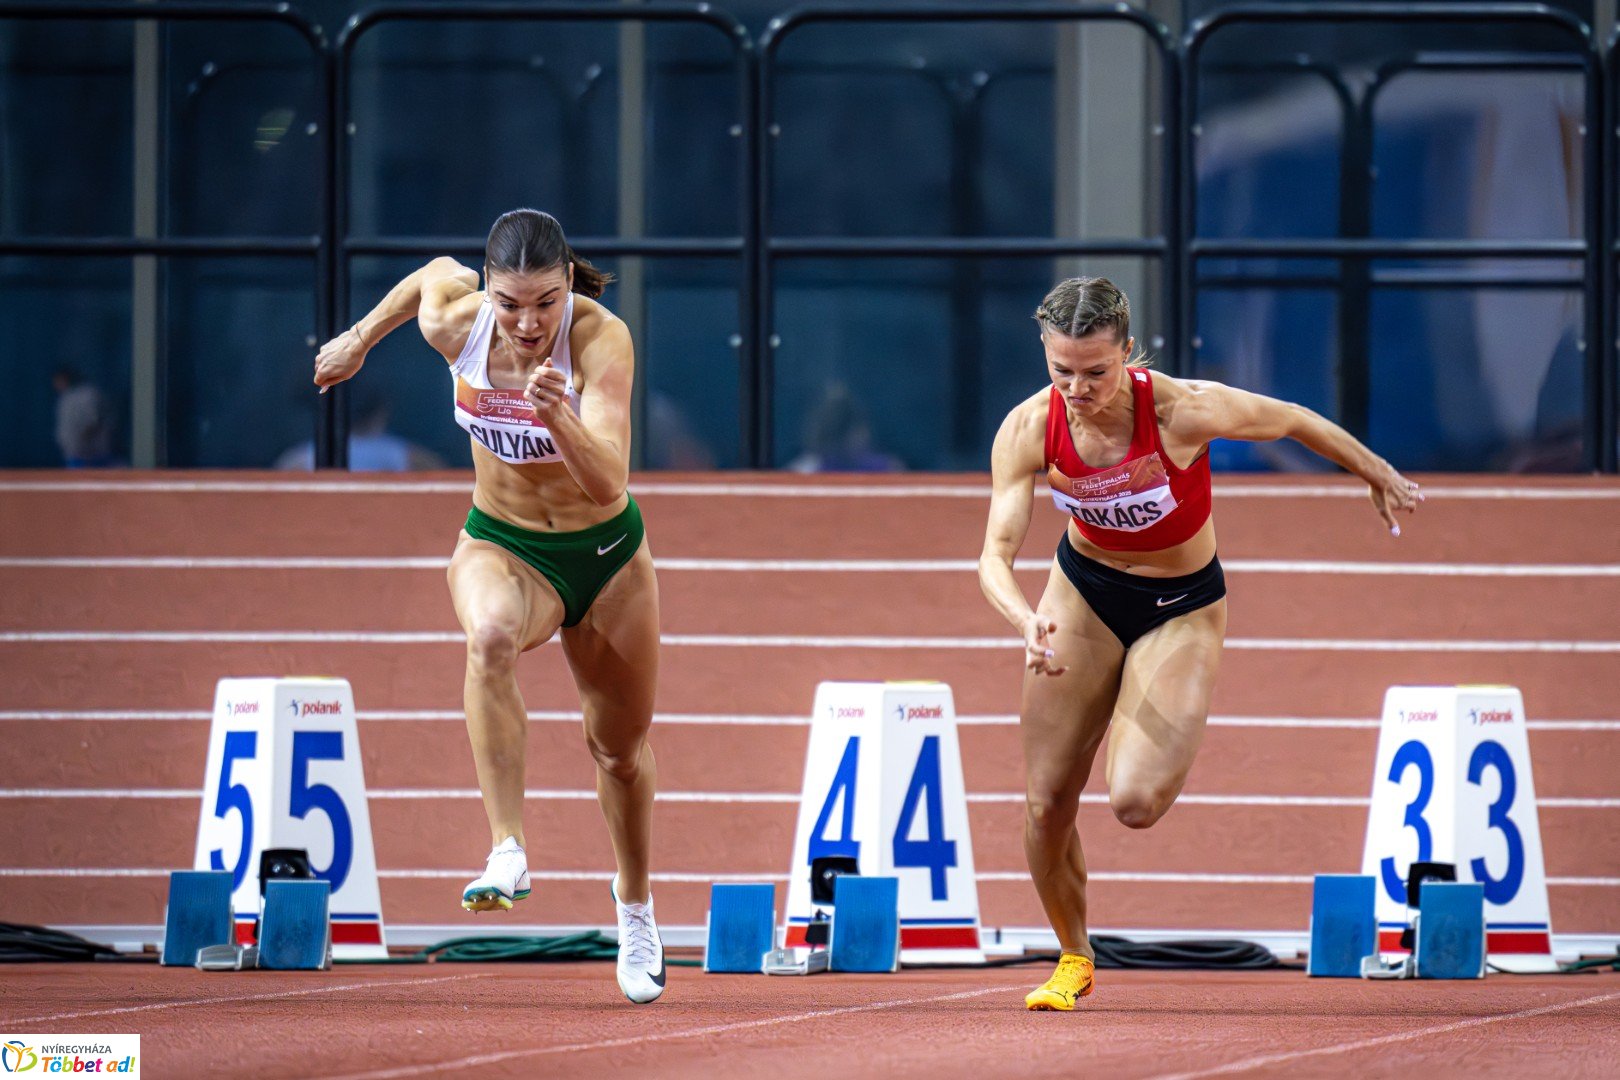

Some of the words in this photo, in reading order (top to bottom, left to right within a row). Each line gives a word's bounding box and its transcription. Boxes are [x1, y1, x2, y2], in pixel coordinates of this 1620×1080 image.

[470, 423, 556, 460] SULYÁN
[1065, 501, 1163, 528] TAKÁCS
[234, 701, 260, 716] polanik
[302, 700, 342, 717] polanik
[907, 704, 943, 722] polanik
[1480, 708, 1514, 726] polanik
[211, 731, 258, 894] 5
[289, 731, 354, 894] 5
[807, 736, 861, 866] 4
[892, 735, 958, 901] 4
[1380, 739, 1435, 905] 3
[1466, 739, 1525, 906] 3
